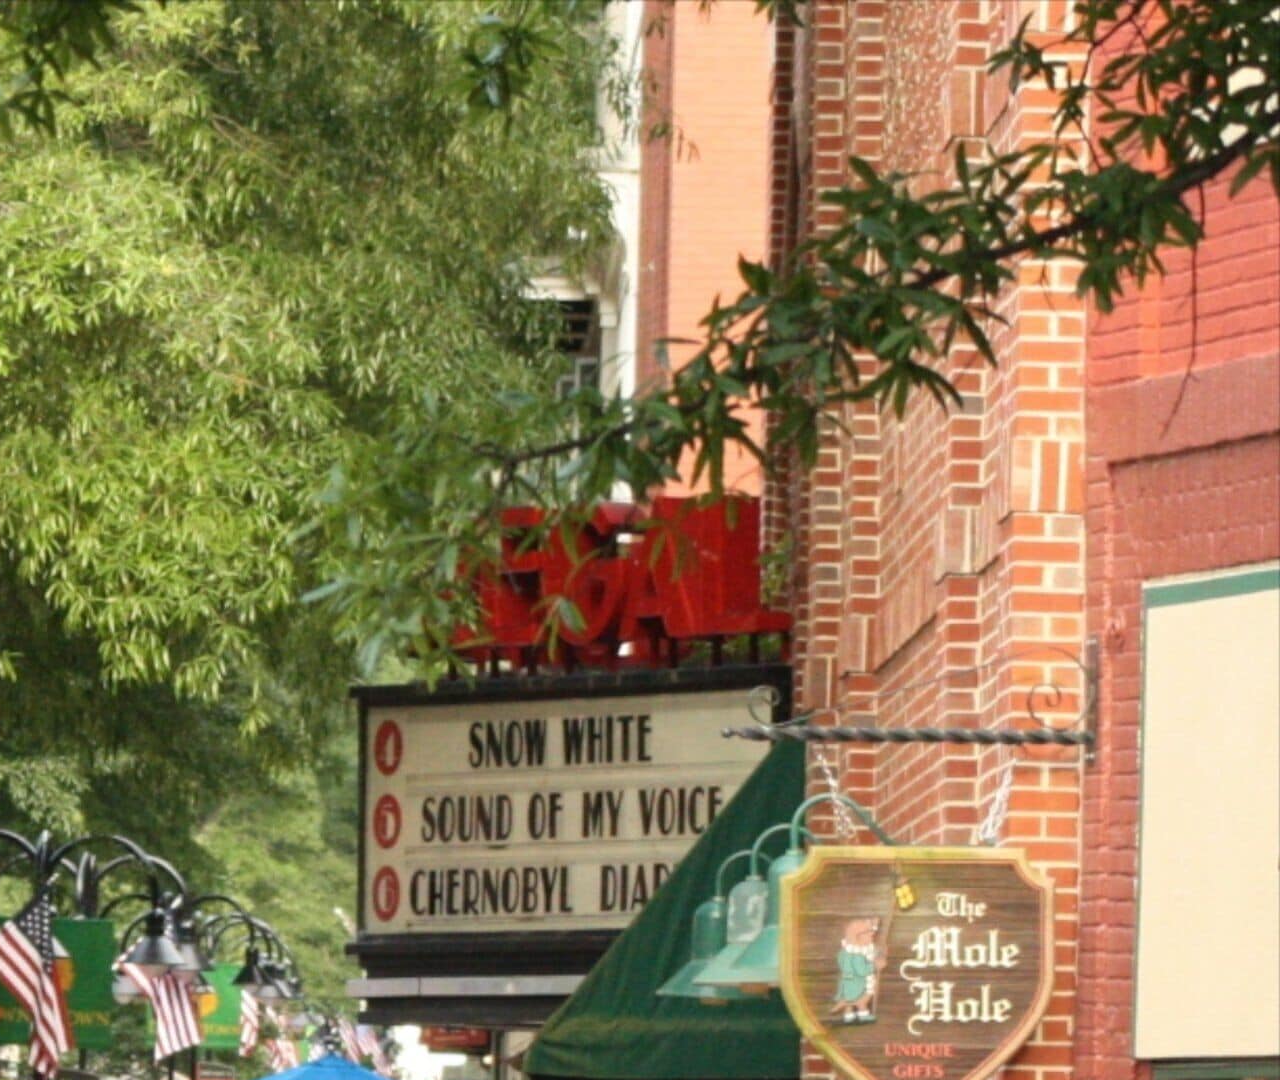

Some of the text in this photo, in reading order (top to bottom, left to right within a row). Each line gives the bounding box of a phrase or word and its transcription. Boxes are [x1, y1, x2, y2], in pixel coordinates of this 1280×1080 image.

[468, 719, 546, 769] SNOW
[562, 714, 653, 766] WHITE
[420, 793, 513, 843] SOUND
[527, 792, 563, 841] OF
[581, 790, 624, 839] MY
[408, 866, 573, 916] CHERNOBYL
[935, 891, 988, 923] The
[899, 925, 1021, 982] Mole
[907, 980, 1014, 1036] Hole
[884, 1043, 956, 1060] UNIQUE
[892, 1063, 945, 1080] GIFTS
